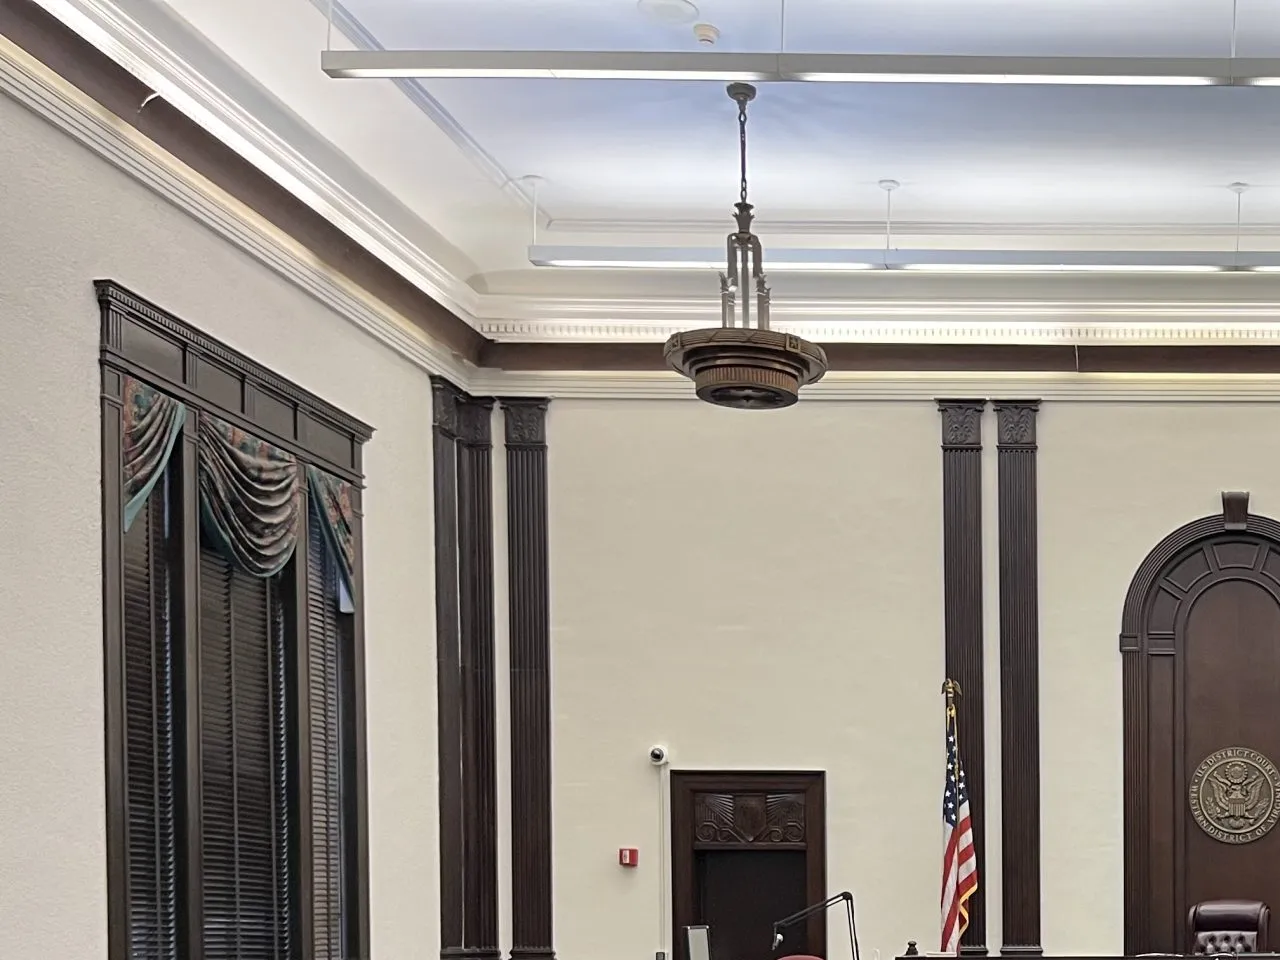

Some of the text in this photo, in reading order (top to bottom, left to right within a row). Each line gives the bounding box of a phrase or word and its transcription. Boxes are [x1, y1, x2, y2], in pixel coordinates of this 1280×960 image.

[1207, 749, 1249, 766] DISTRICT
[1250, 751, 1276, 776] COURT
[1190, 785, 1210, 829] WESTERN
[1208, 827, 1253, 843] DISTRICT
[1255, 824, 1269, 836] OF
